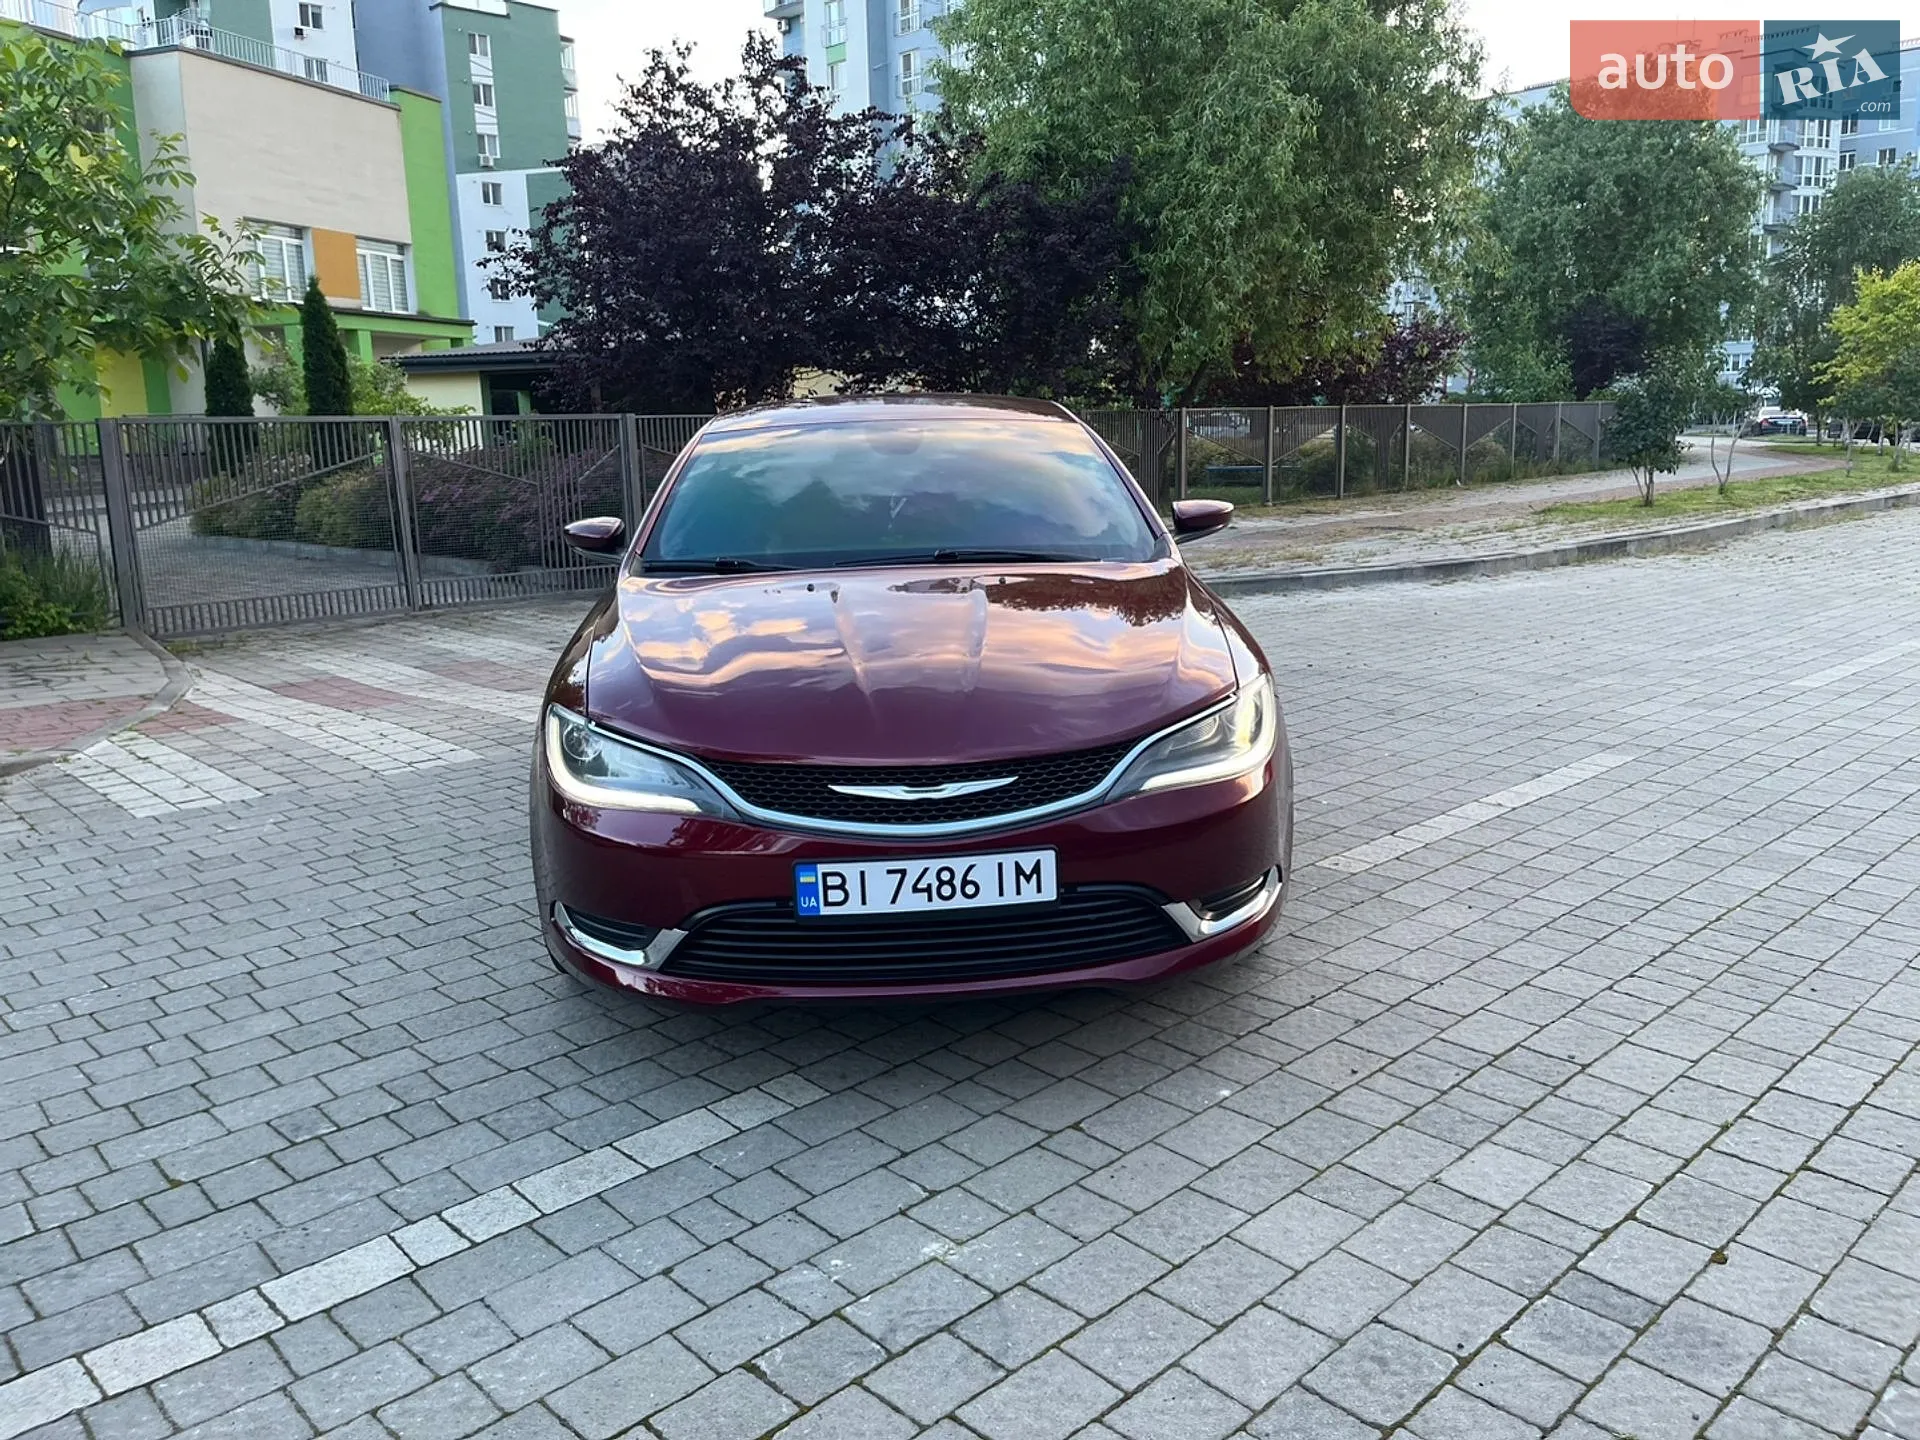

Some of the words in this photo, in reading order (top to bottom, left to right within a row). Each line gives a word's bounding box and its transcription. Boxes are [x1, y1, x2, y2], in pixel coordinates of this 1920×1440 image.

[821, 870, 867, 907] BI
[886, 864, 981, 905] 7486
[997, 858, 1042, 897] IM
[800, 896, 818, 908] UA
